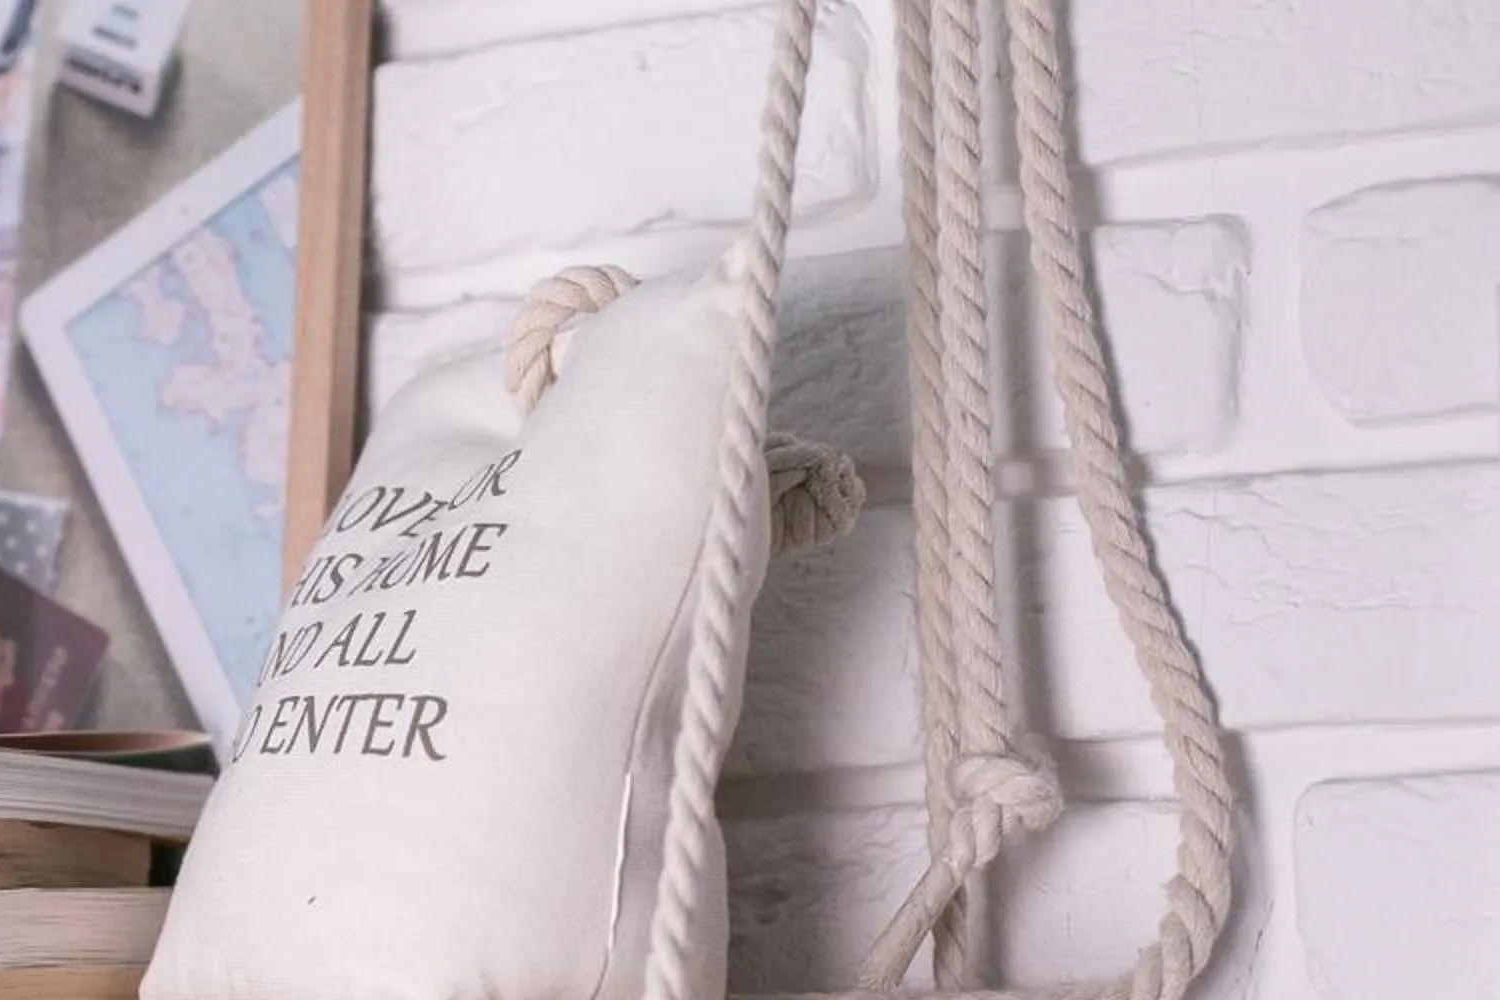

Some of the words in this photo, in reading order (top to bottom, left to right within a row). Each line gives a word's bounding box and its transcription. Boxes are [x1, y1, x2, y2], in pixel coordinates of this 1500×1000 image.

[336, 485, 449, 538] OVE
[447, 448, 522, 511] OR
[291, 552, 364, 608] HIS
[257, 620, 324, 687] ND
[313, 609, 418, 668] ALL
[259, 692, 449, 761] ENTER
